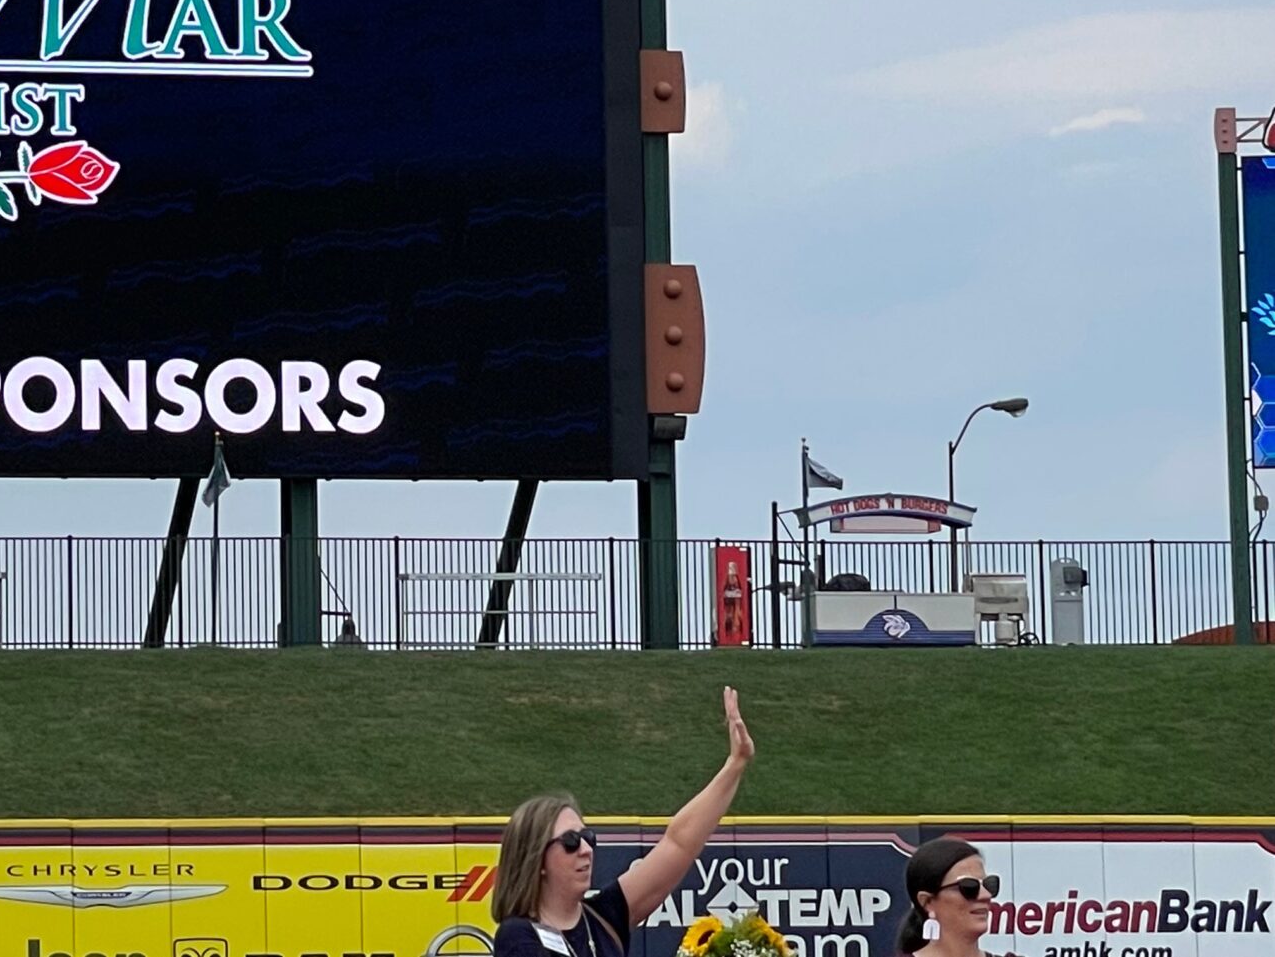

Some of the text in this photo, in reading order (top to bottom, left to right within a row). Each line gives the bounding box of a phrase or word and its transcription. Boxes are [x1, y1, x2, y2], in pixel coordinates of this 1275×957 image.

[829, 503, 850, 516] HOT
[853, 497, 880, 511] DOGS
[900, 496, 949, 515] BURGERS
[6, 863, 195, 877] CHRYSLER
[252, 874, 470, 891] DODGE
[693, 857, 789, 896] your
[756, 888, 891, 927] TEMP
[987, 888, 1273, 936] mericanBank
